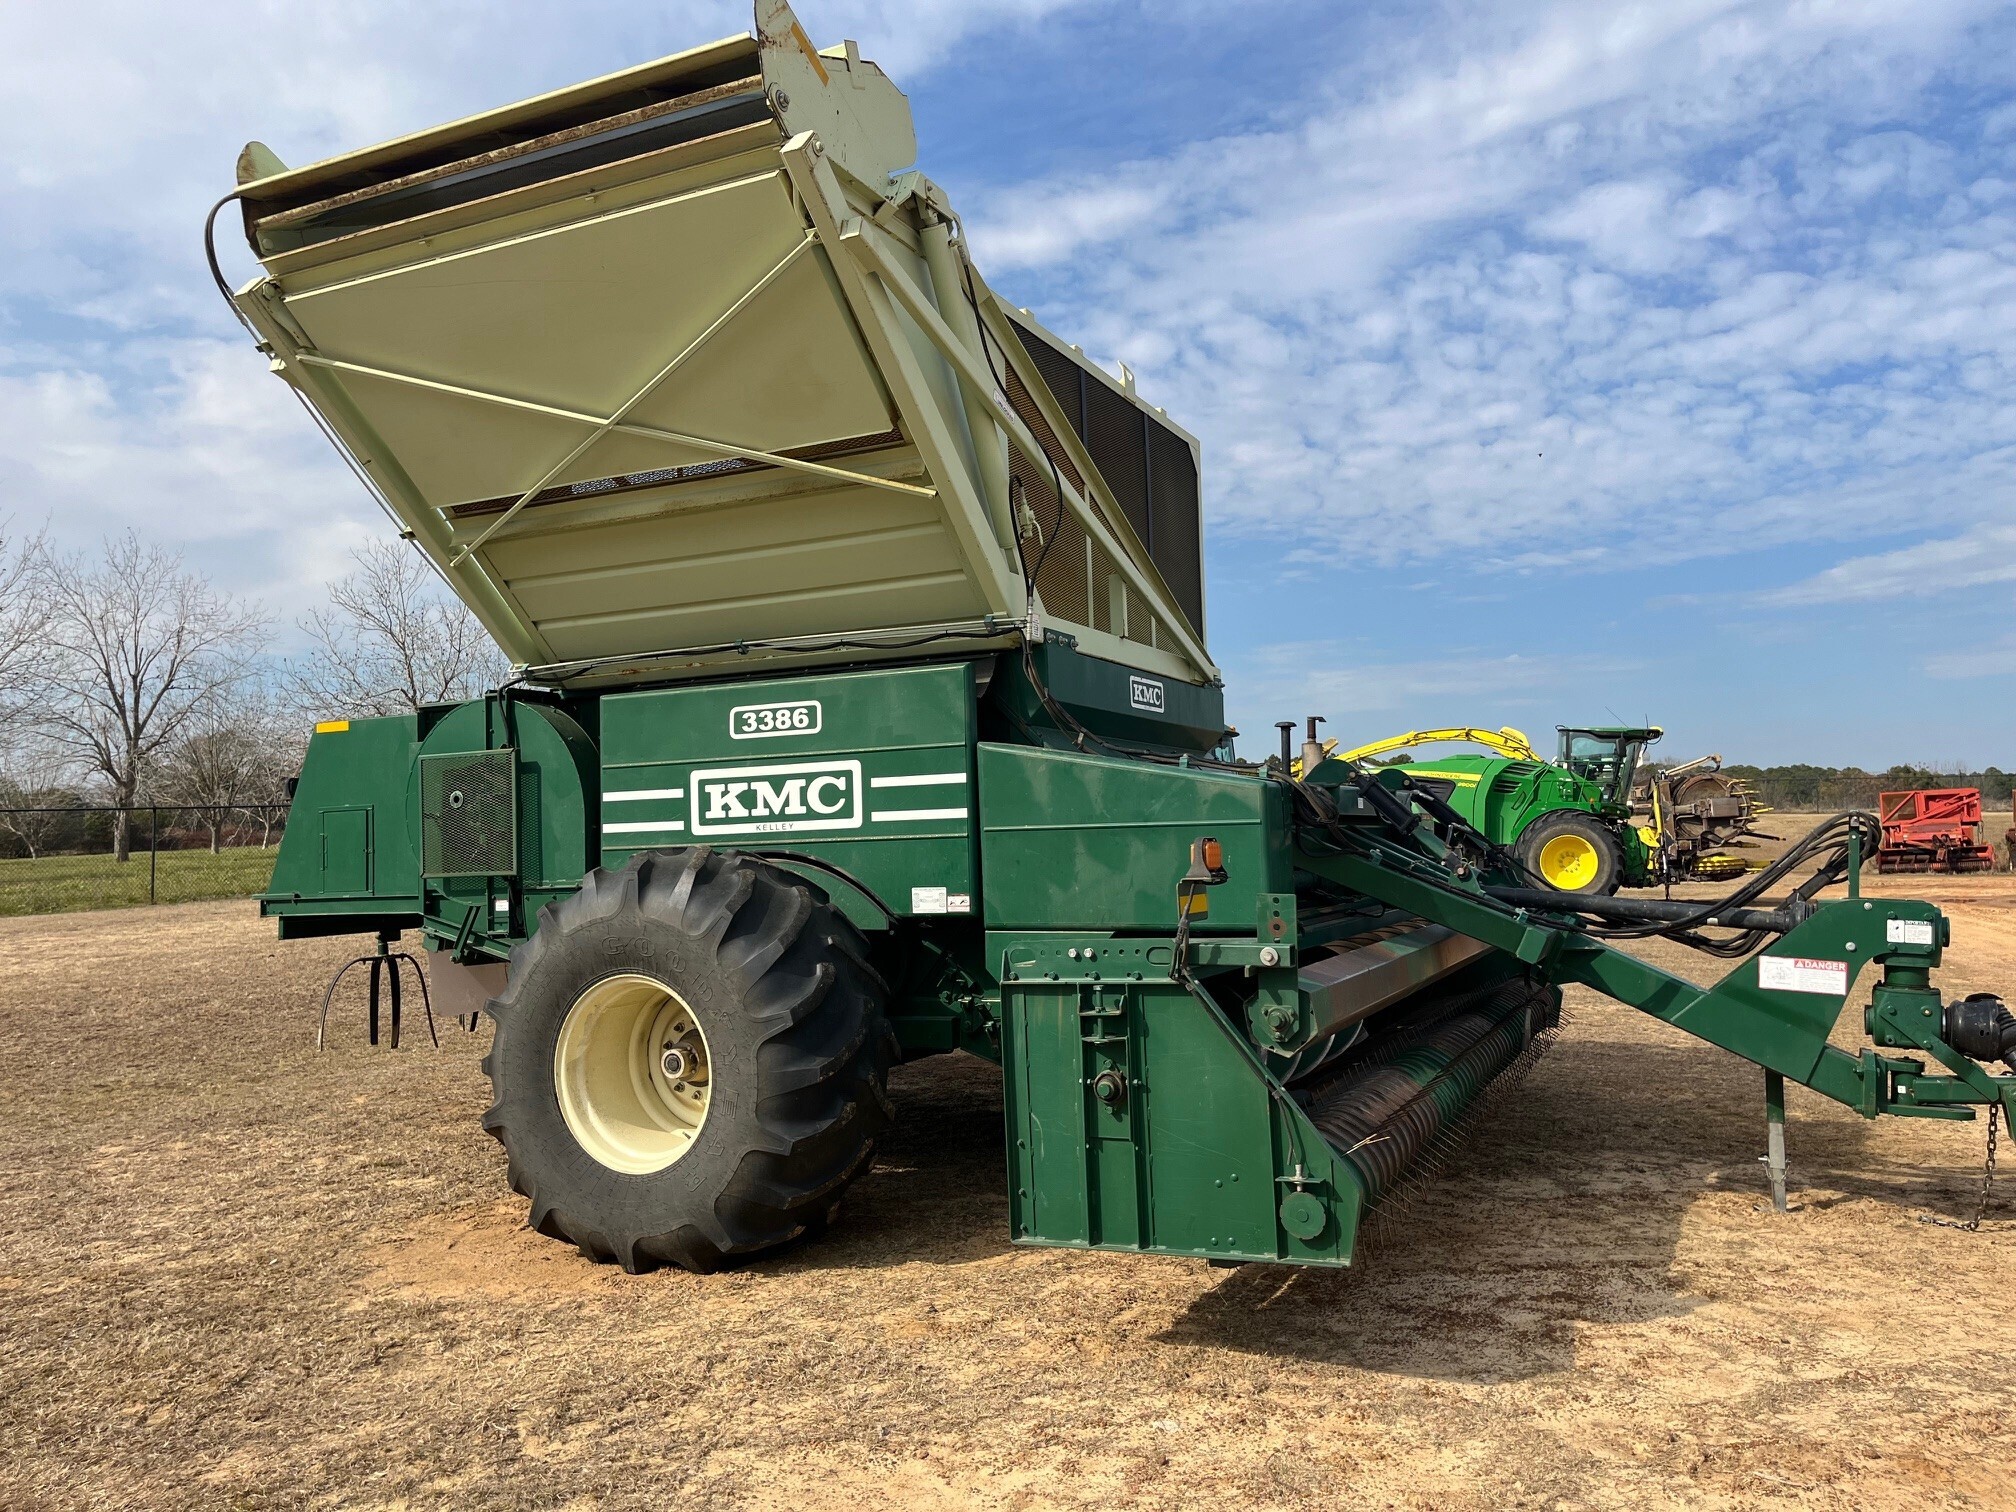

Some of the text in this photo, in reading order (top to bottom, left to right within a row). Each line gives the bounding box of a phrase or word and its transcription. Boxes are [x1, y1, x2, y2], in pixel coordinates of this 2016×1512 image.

[1133, 684, 1161, 705] KMC
[742, 708, 809, 732] 3386
[705, 776, 846, 818] KMC
[756, 822, 794, 831] KELLEY
[1805, 961, 1846, 971] DANGER
